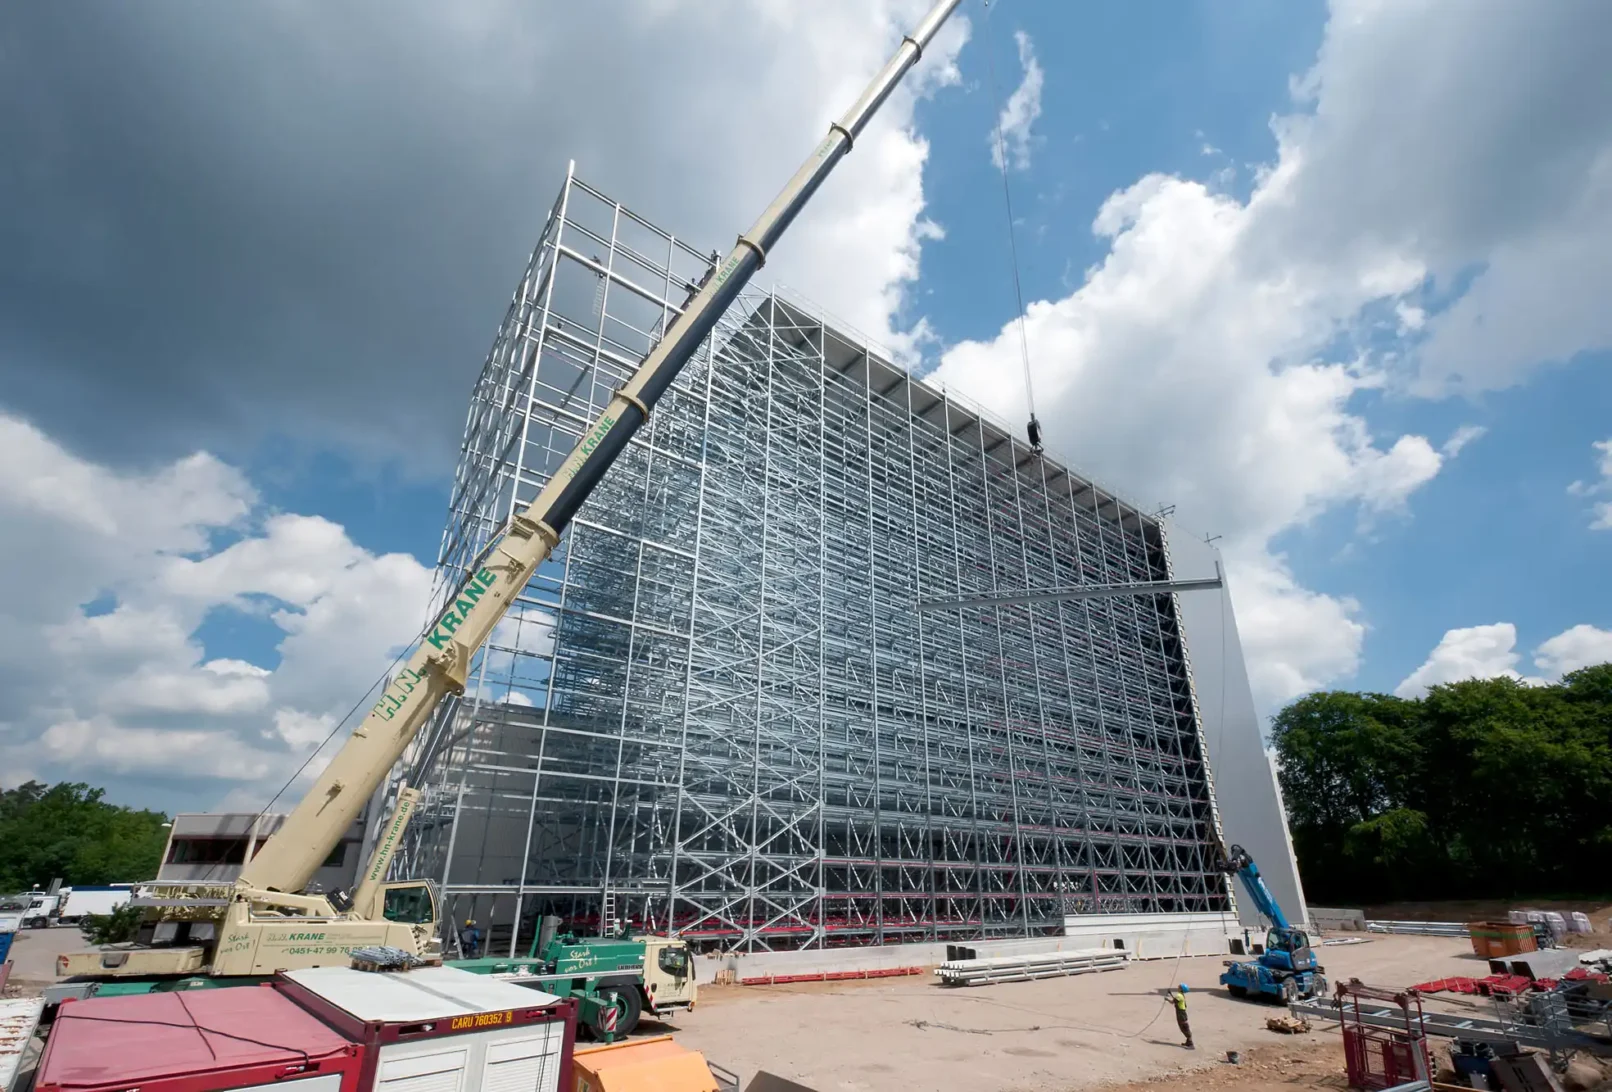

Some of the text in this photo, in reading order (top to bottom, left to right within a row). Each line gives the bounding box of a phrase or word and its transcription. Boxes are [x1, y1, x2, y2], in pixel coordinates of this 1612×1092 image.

[716, 256, 739, 283] KRANE
[581, 415, 615, 456] KRANE
[373, 567, 497, 721] H.N. KRANE
[369, 801, 410, 881] www.hn-krane.de
[227, 932, 249, 943] Stark
[288, 932, 326, 941] KRANE
[289, 946, 324, 955] 0451-47
[326, 946, 337, 954] 99
[339, 946, 350, 954] 76
[570, 947, 591, 959] Stark
[565, 965, 577, 973] vor
[452, 1011, 512, 1029] CARU 760352 9
